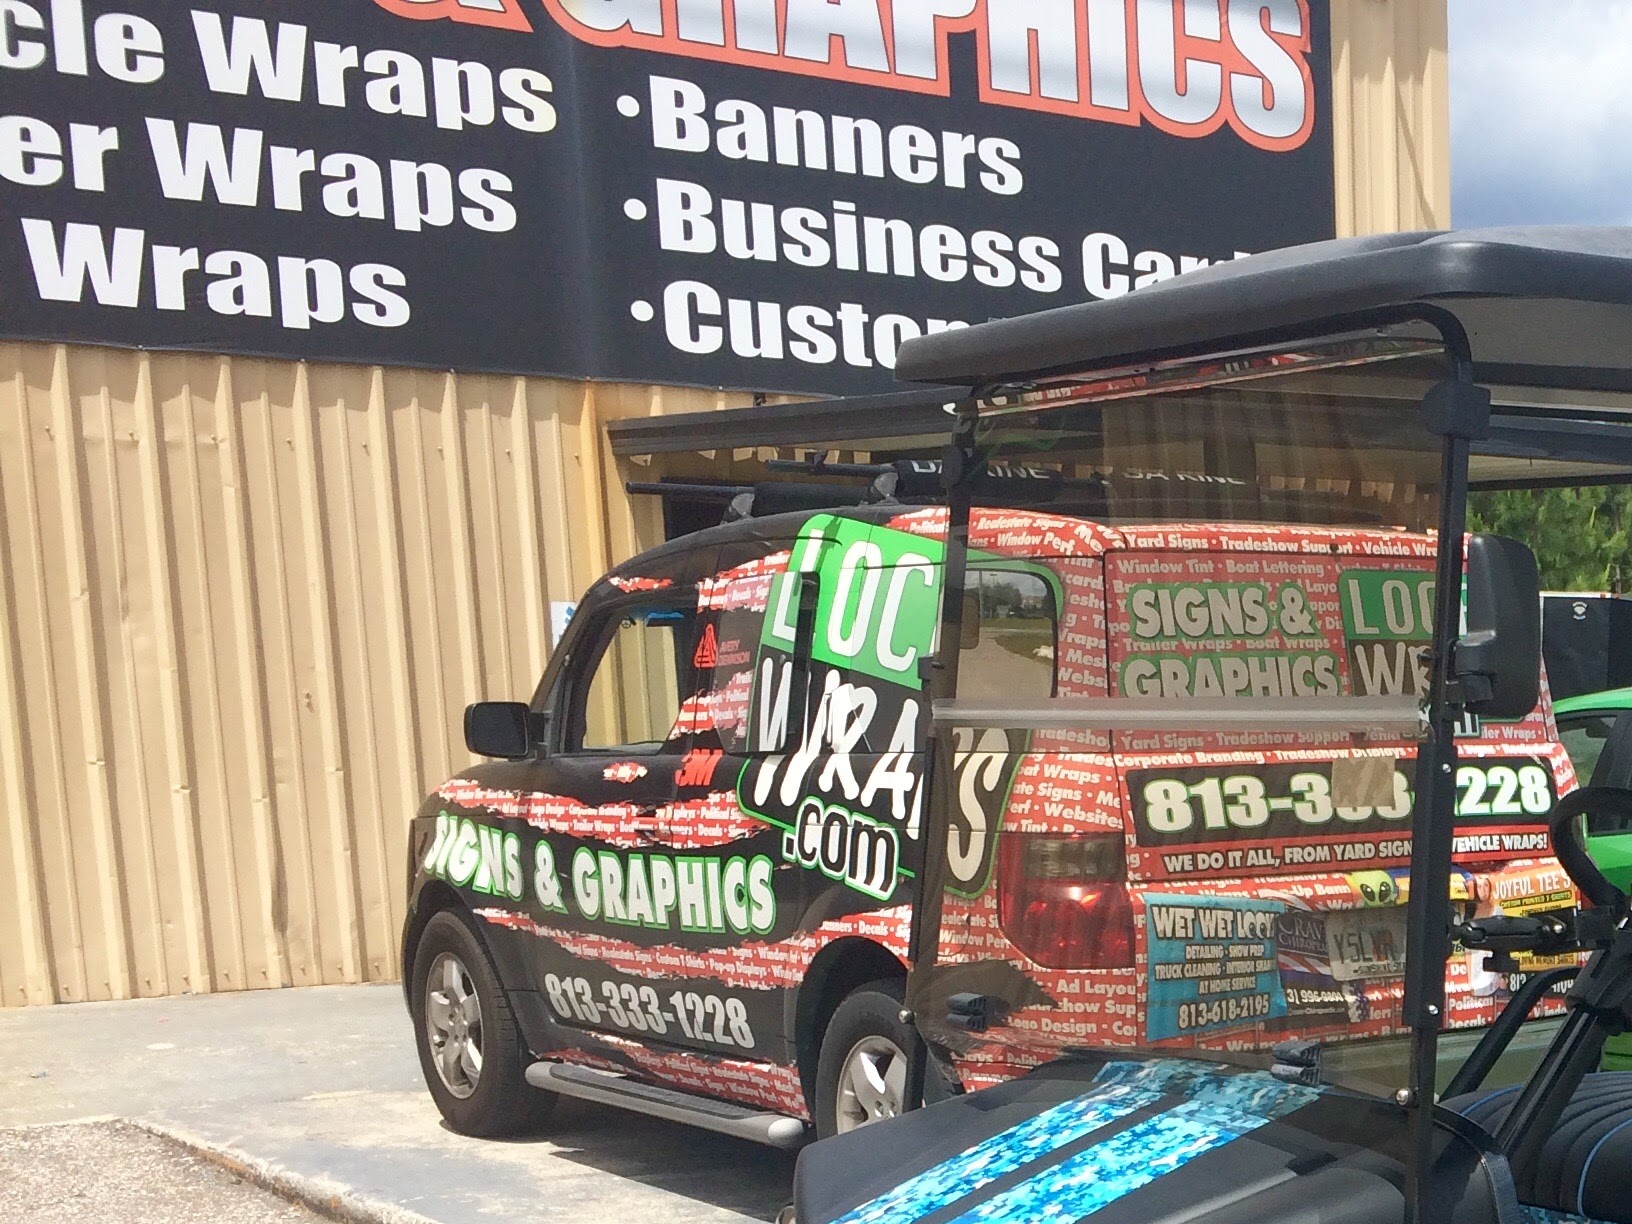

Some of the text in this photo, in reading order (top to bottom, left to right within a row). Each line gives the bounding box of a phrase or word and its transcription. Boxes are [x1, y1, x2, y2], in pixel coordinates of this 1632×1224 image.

[190, 9, 557, 133] Wraps
[648, 75, 1023, 196] Banners
[144, 117, 517, 232] Wraps
[656, 178, 1062, 294] Business
[20, 218, 411, 330] Wraps
[997, 532, 1043, 548] Window
[1125, 533, 1165, 549] Yard
[1168, 533, 1209, 551] Signs
[1219, 536, 1299, 553] Tradeshow
[1362, 541, 1410, 556] Vehicle
[1116, 558, 1183, 574] Window
[1186, 559, 1215, 574] Tint
[1225, 559, 1260, 574] Boat
[1262, 560, 1325, 577] Lettering
[1132, 586, 1269, 639] SIGNS
[1279, 586, 1316, 636] &
[1124, 655, 1340, 698] GRAPHICS
[1120, 734, 1161, 751] Yard
[1163, 733, 1205, 750] Signs
[1215, 731, 1295, 748] Tradeshow
[1501, 726, 1537, 742] Wraps
[1043, 764, 1101, 786] Wraps
[1114, 752, 1193, 770] Corporate
[1196, 750, 1265, 766] Branding
[1036, 782, 1083, 802] Signs
[1043, 801, 1124, 831] Websites
[784, 799, 899, 897] .com
[1163, 853, 1195, 873] WE
[1197, 851, 1224, 870] DO
[1227, 850, 1244, 868] IT
[1246, 847, 1281, 868] ALL,
[1284, 844, 1332, 864] FROM
[1333, 841, 1374, 861] YARD
[1501, 832, 1548, 851] WRAPS!
[424, 813, 776, 933] SIGNS & GRAPHICS
[1492, 874, 1535, 900] JOYFUL
[858, 919, 889, 937] Decals
[1151, 905, 1196, 939] WET
[1198, 908, 1235, 939] WET
[1185, 944, 1224, 960] DETAILING
[1056, 978, 1080, 994] Ad
[1154, 963, 1182, 980] TRUCK
[1184, 962, 1222, 978] CLEANING
[544, 972, 756, 1049] 813-333-1228
[1178, 993, 1270, 1029] 813-618-2195
[1041, 1018, 1098, 1036] Design
